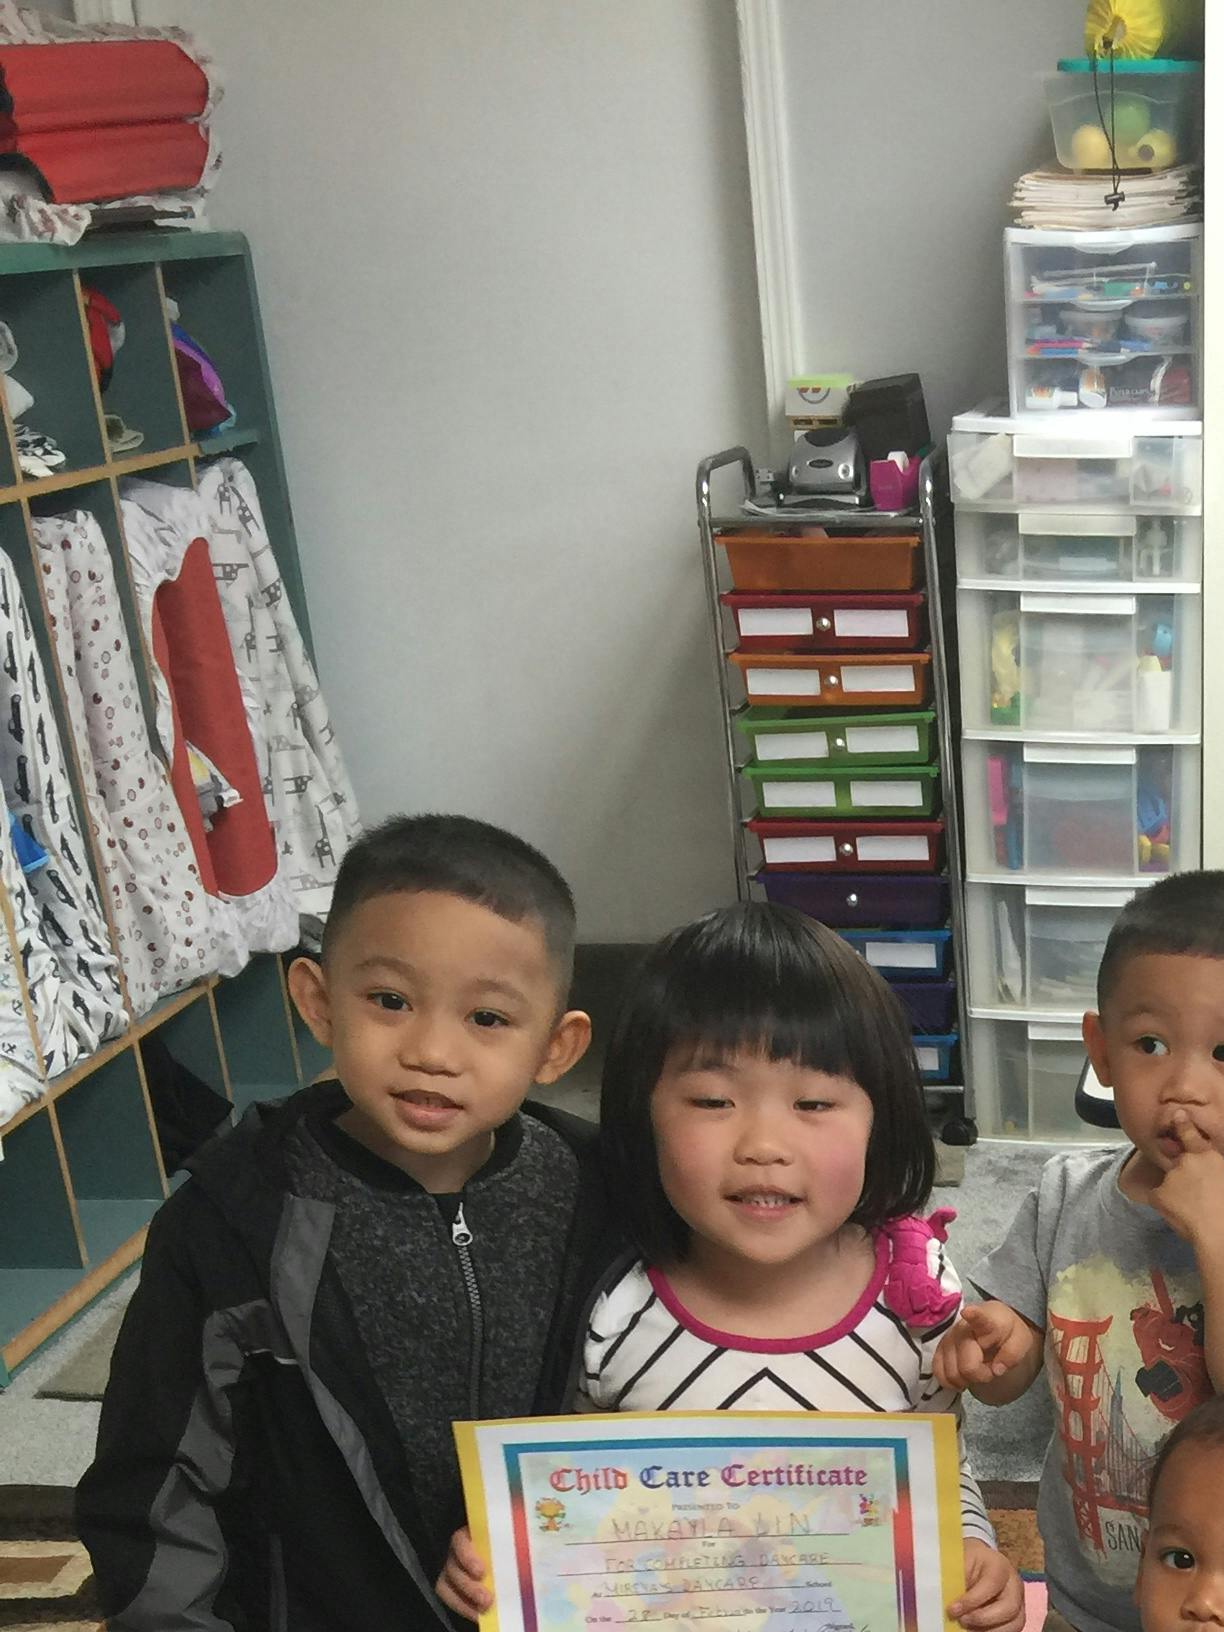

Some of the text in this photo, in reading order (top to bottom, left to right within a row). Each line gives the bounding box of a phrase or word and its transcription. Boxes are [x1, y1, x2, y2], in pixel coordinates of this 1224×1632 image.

[549, 1464, 867, 1495] Child Care Certificate
[612, 1511, 811, 1539] MAKAYLA LIN
[1105, 1520, 1141, 1552] SAN
